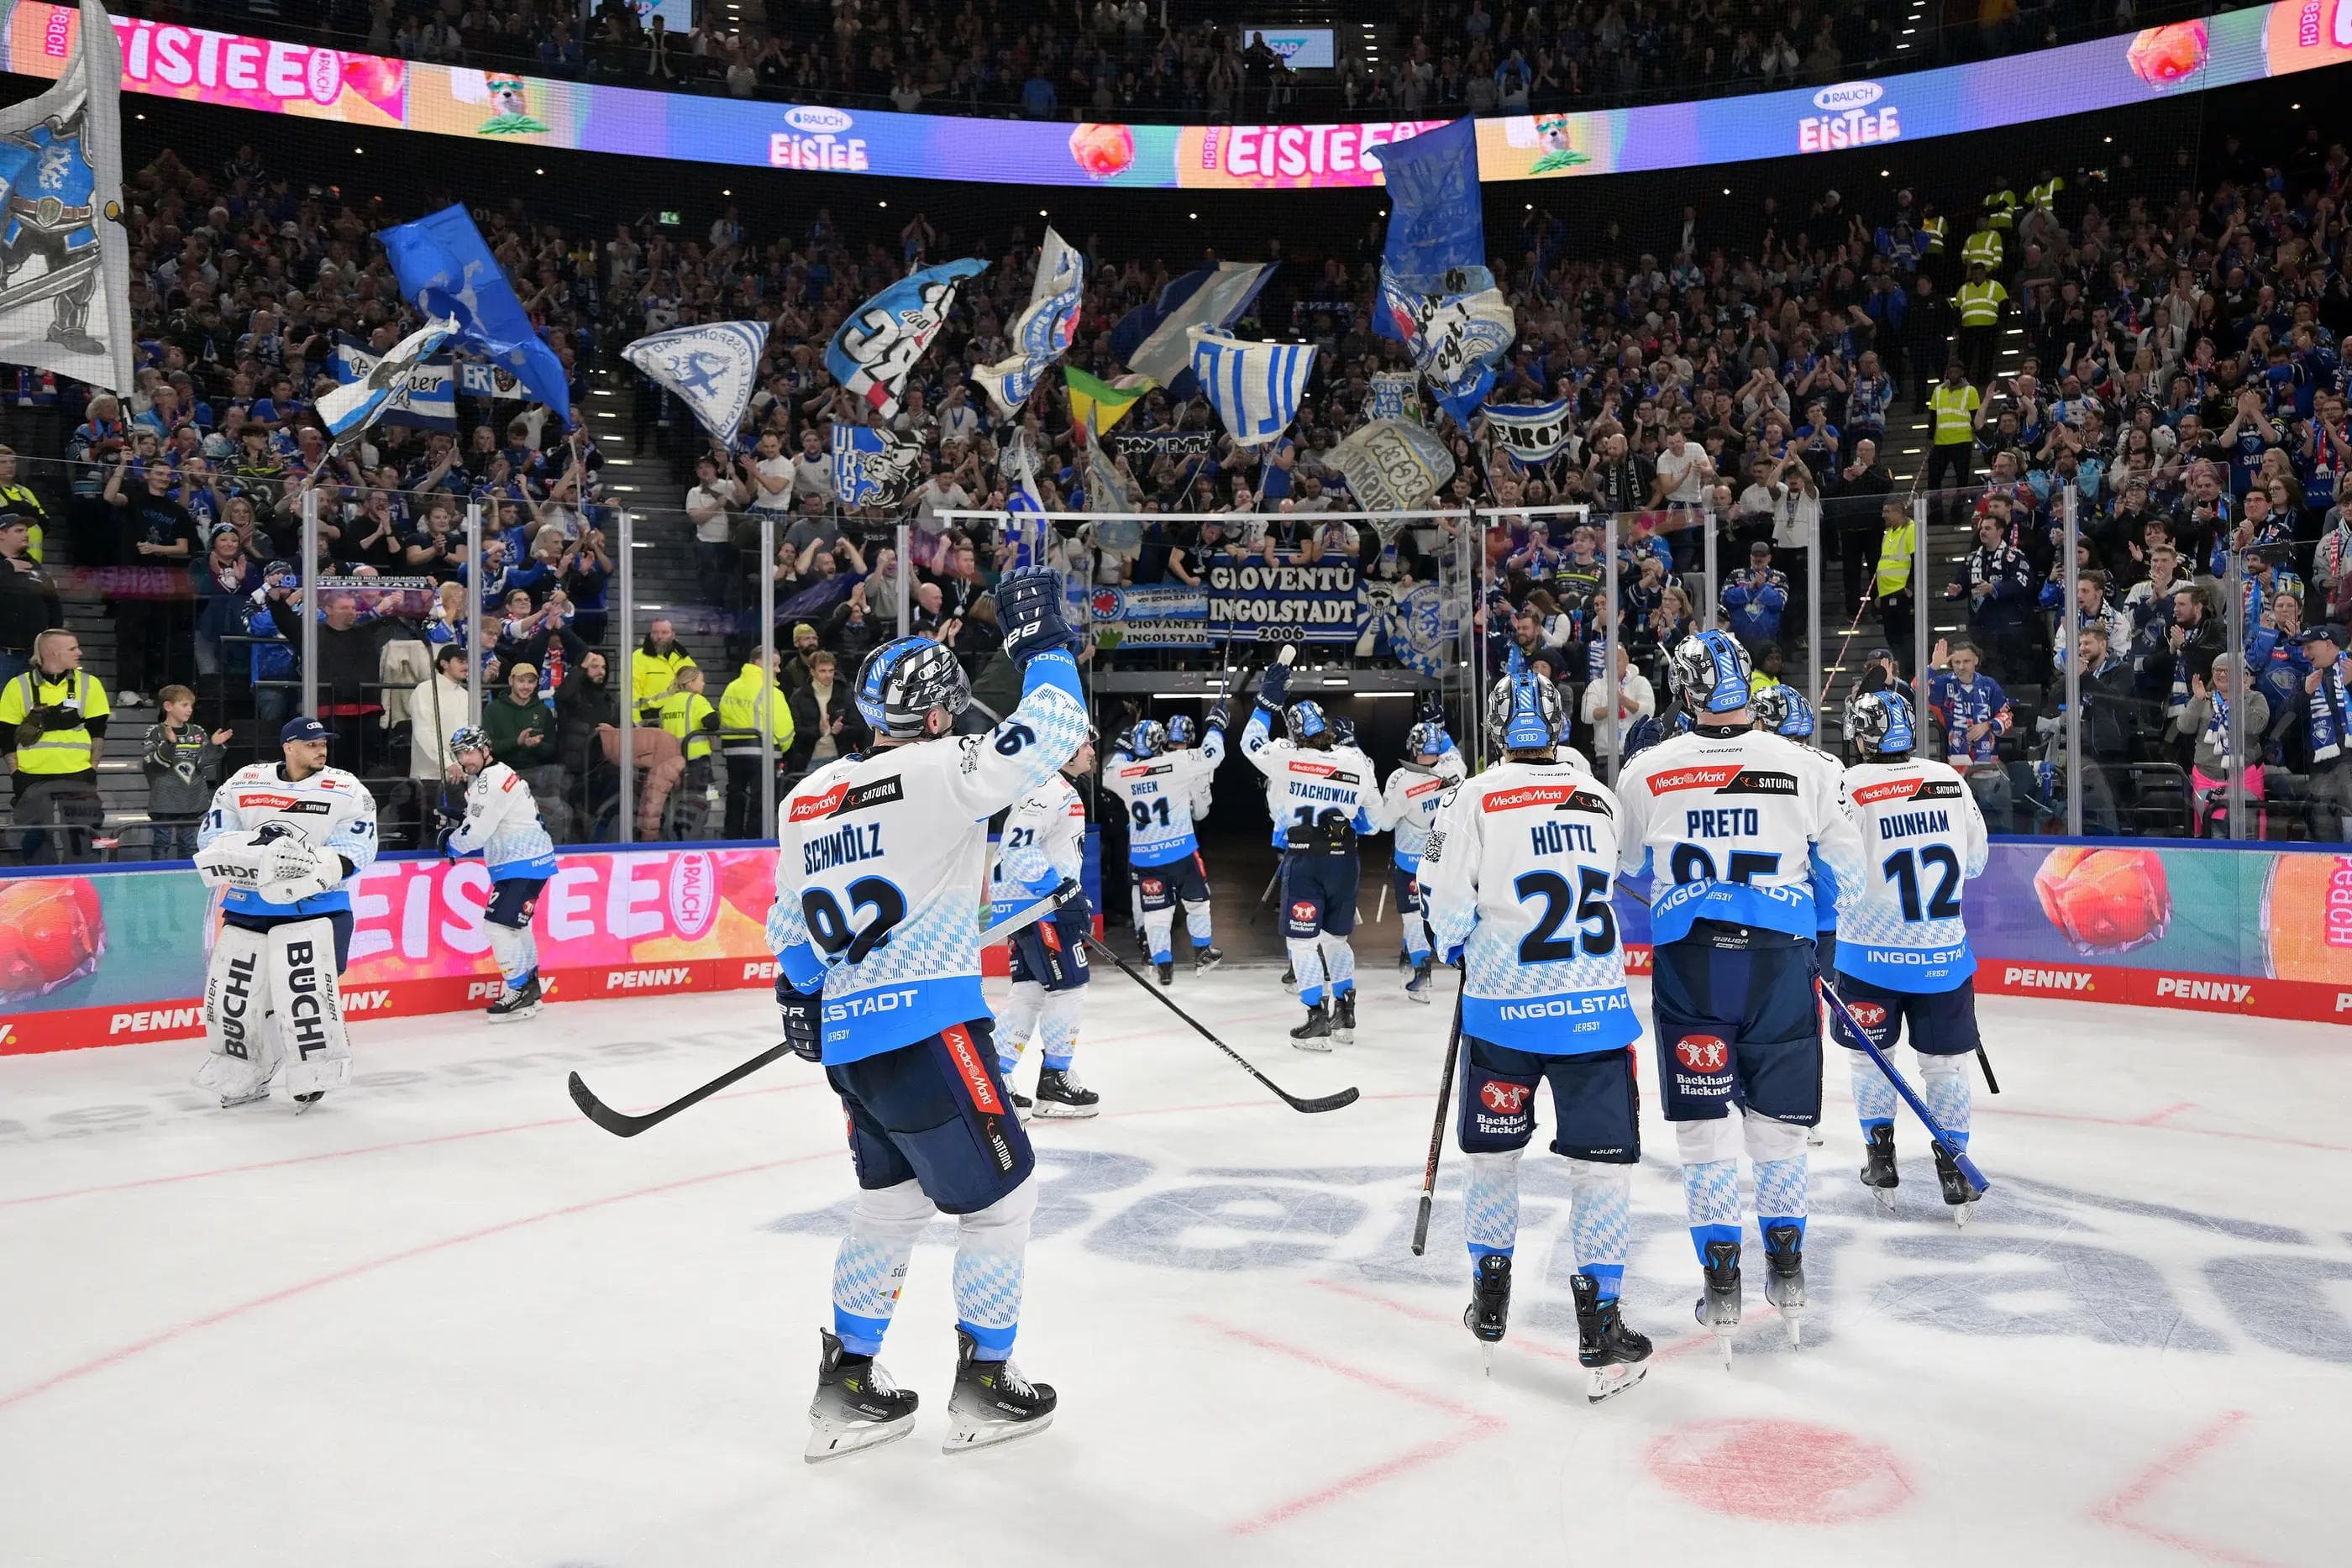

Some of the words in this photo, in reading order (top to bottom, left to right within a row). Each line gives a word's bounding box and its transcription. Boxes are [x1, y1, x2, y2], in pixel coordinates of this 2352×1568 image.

[1270, 41, 1299, 55] SAP
[316, 58, 330, 94] RAUCH
[1832, 88, 1873, 102] RAUCH
[803, 113, 843, 127] RAUCH
[1210, 562, 1356, 591] GIOVENTÙ
[1210, 600, 1357, 622] INGOLSTADT
[1258, 627, 1305, 642] 2006
[891, 679, 903, 687] 92
[861, 783, 896, 802] SATURN
[1131, 780, 1158, 796] SHEEN
[1289, 781, 1358, 805] STACHOWIAK
[1758, 777, 1795, 790] SATURN
[1935, 785, 1961, 795] SATURN
[1131, 797, 1170, 831] 91
[1686, 808, 1758, 838] PRETO
[1879, 810, 1950, 840] DUNHAM
[1008, 826, 1035, 847] 21
[1530, 821, 1597, 856] HÜTTL
[803, 822, 885, 876] SCHMÖLZ
[683, 866, 702, 921] RAUCH
[1882, 843, 1961, 924] 12
[801, 874, 908, 966] 92
[1513, 864, 1617, 966] 25
[222, 952, 257, 1061] BÜCHL
[286, 940, 327, 1062] BÜCHL
[1676, 1072, 1734, 1085] Backhaus
[1680, 1083, 1732, 1096] Hackner
[991, 1134, 1013, 1172] SATURN
[860, 1403, 889, 1418] BAUER
[996, 1401, 1027, 1417] BAUER
